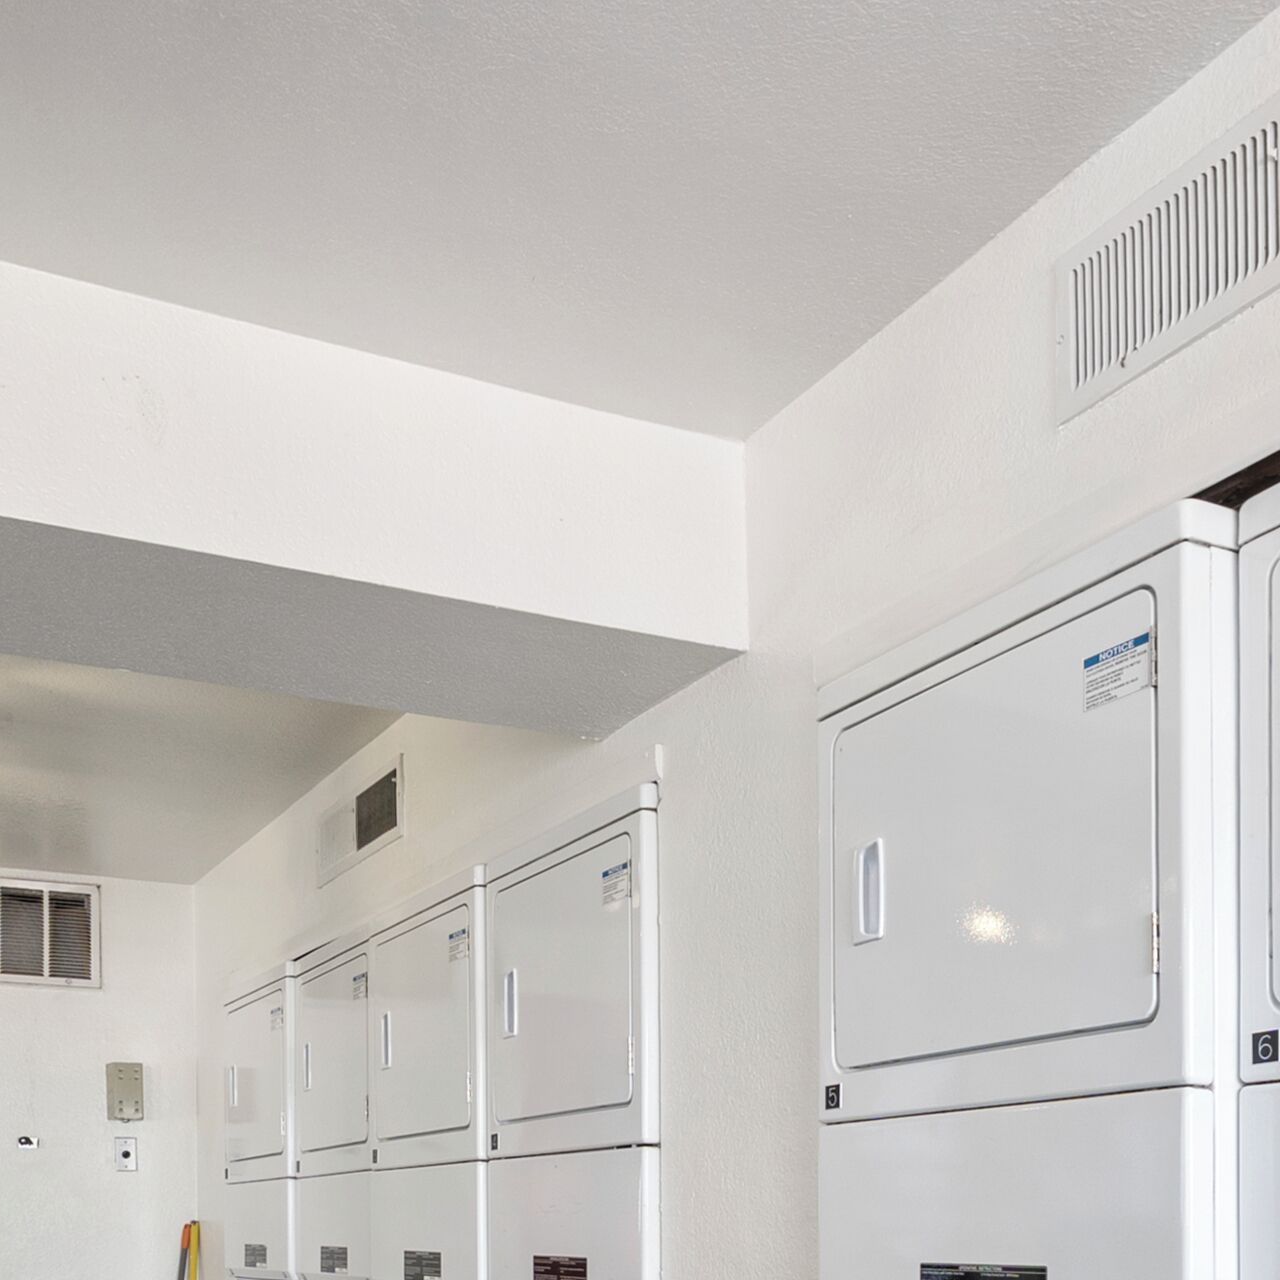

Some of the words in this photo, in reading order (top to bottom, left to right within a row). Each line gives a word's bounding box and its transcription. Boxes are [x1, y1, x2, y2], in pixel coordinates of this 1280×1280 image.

[1098, 639, 1135, 661] NOTICE
[1258, 1034, 1273, 1060] 6
[827, 1087, 837, 1107] 5
